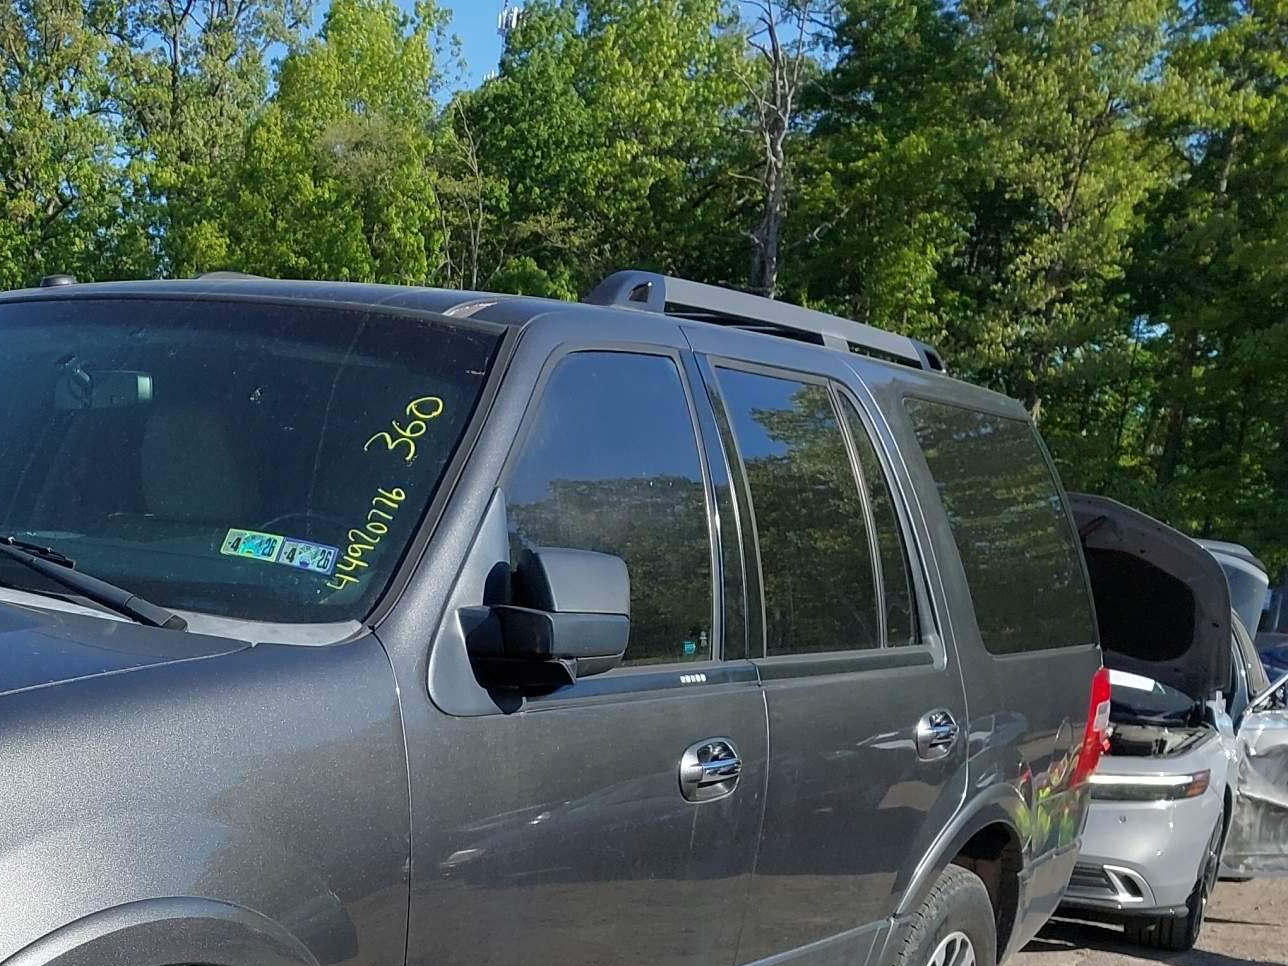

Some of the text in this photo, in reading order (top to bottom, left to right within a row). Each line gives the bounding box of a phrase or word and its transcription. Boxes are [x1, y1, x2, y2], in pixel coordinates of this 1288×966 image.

[326, 396, 444, 590] 44920776 360
[316, 549, 332, 570] 26
